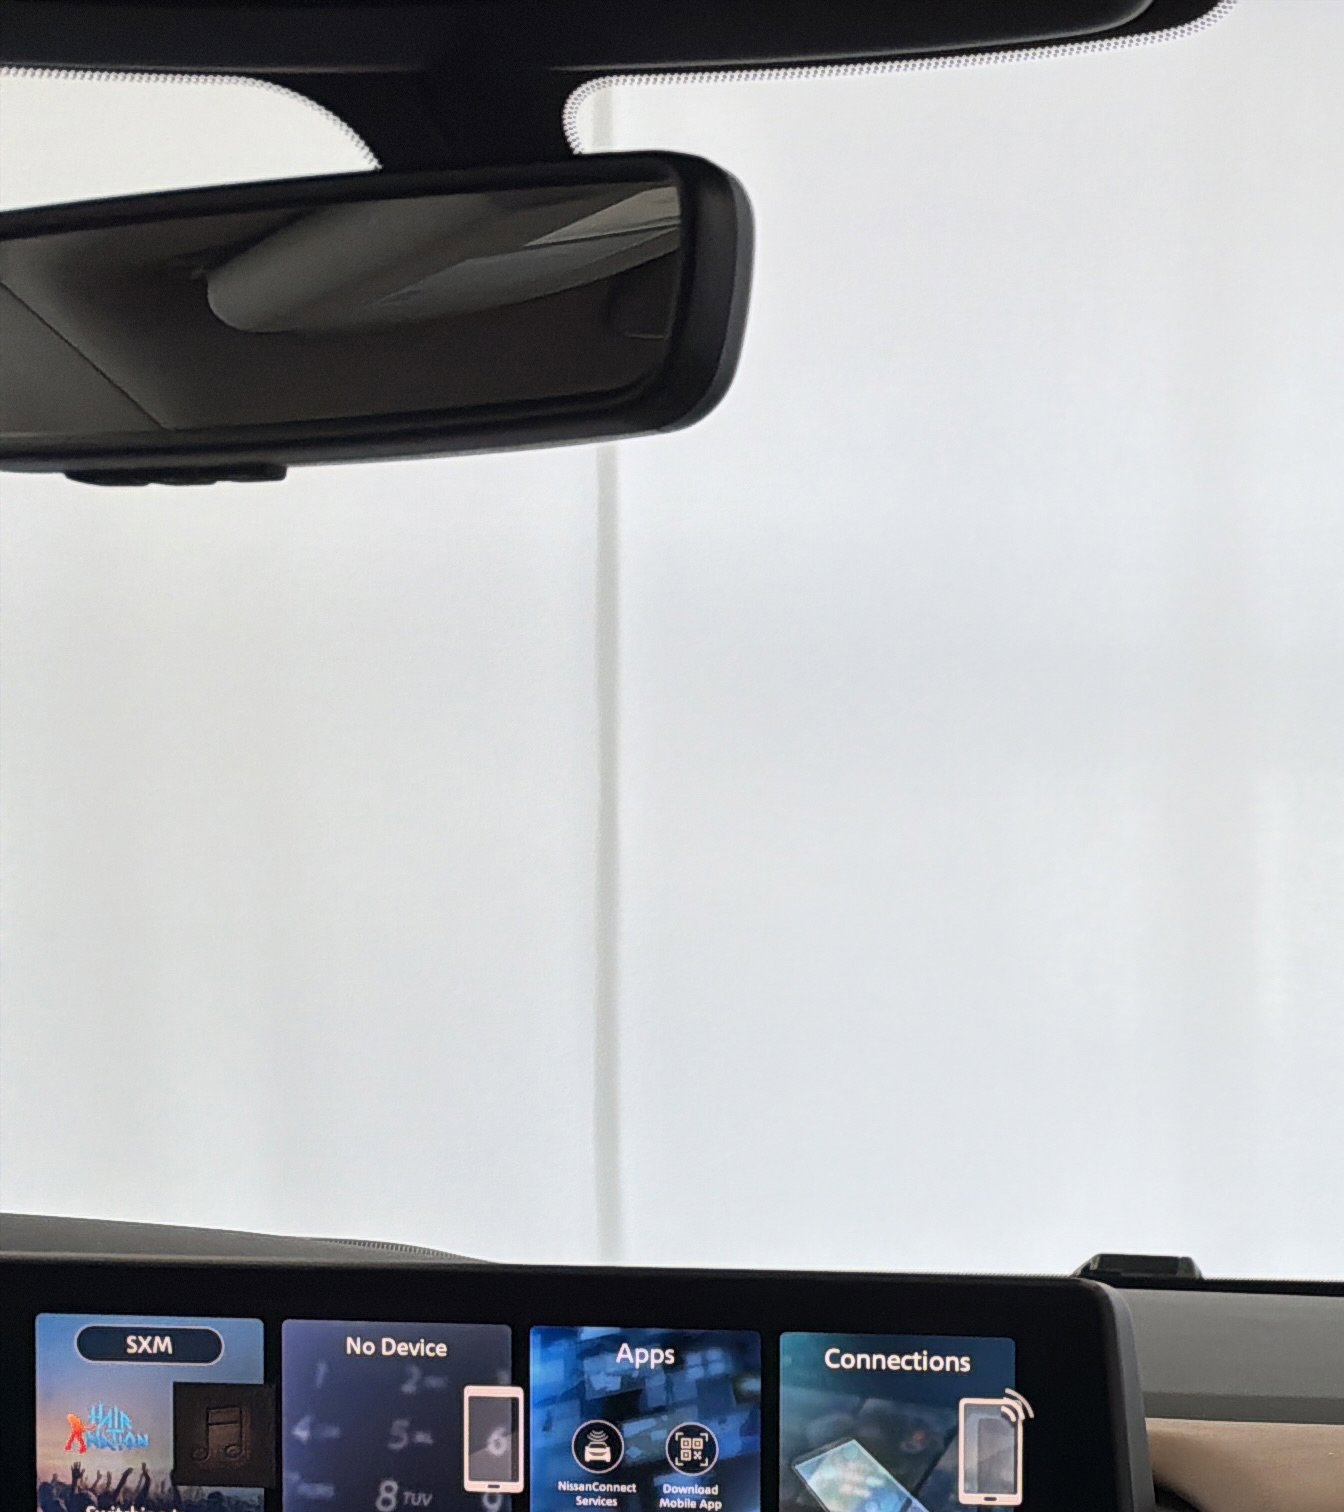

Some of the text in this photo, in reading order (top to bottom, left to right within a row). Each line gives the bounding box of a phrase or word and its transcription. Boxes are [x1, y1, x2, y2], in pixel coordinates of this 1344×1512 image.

[126, 1335, 173, 1355] SXM
[346, 1336, 448, 1357] No Device
[616, 1342, 675, 1368] Apps
[824, 1348, 971, 1373] Connections
[558, 1481, 637, 1493] NissanConnect
[662, 1483, 719, 1496] Download
[575, 1495, 618, 1507] Services
[659, 1497, 723, 1512] Mobile App
